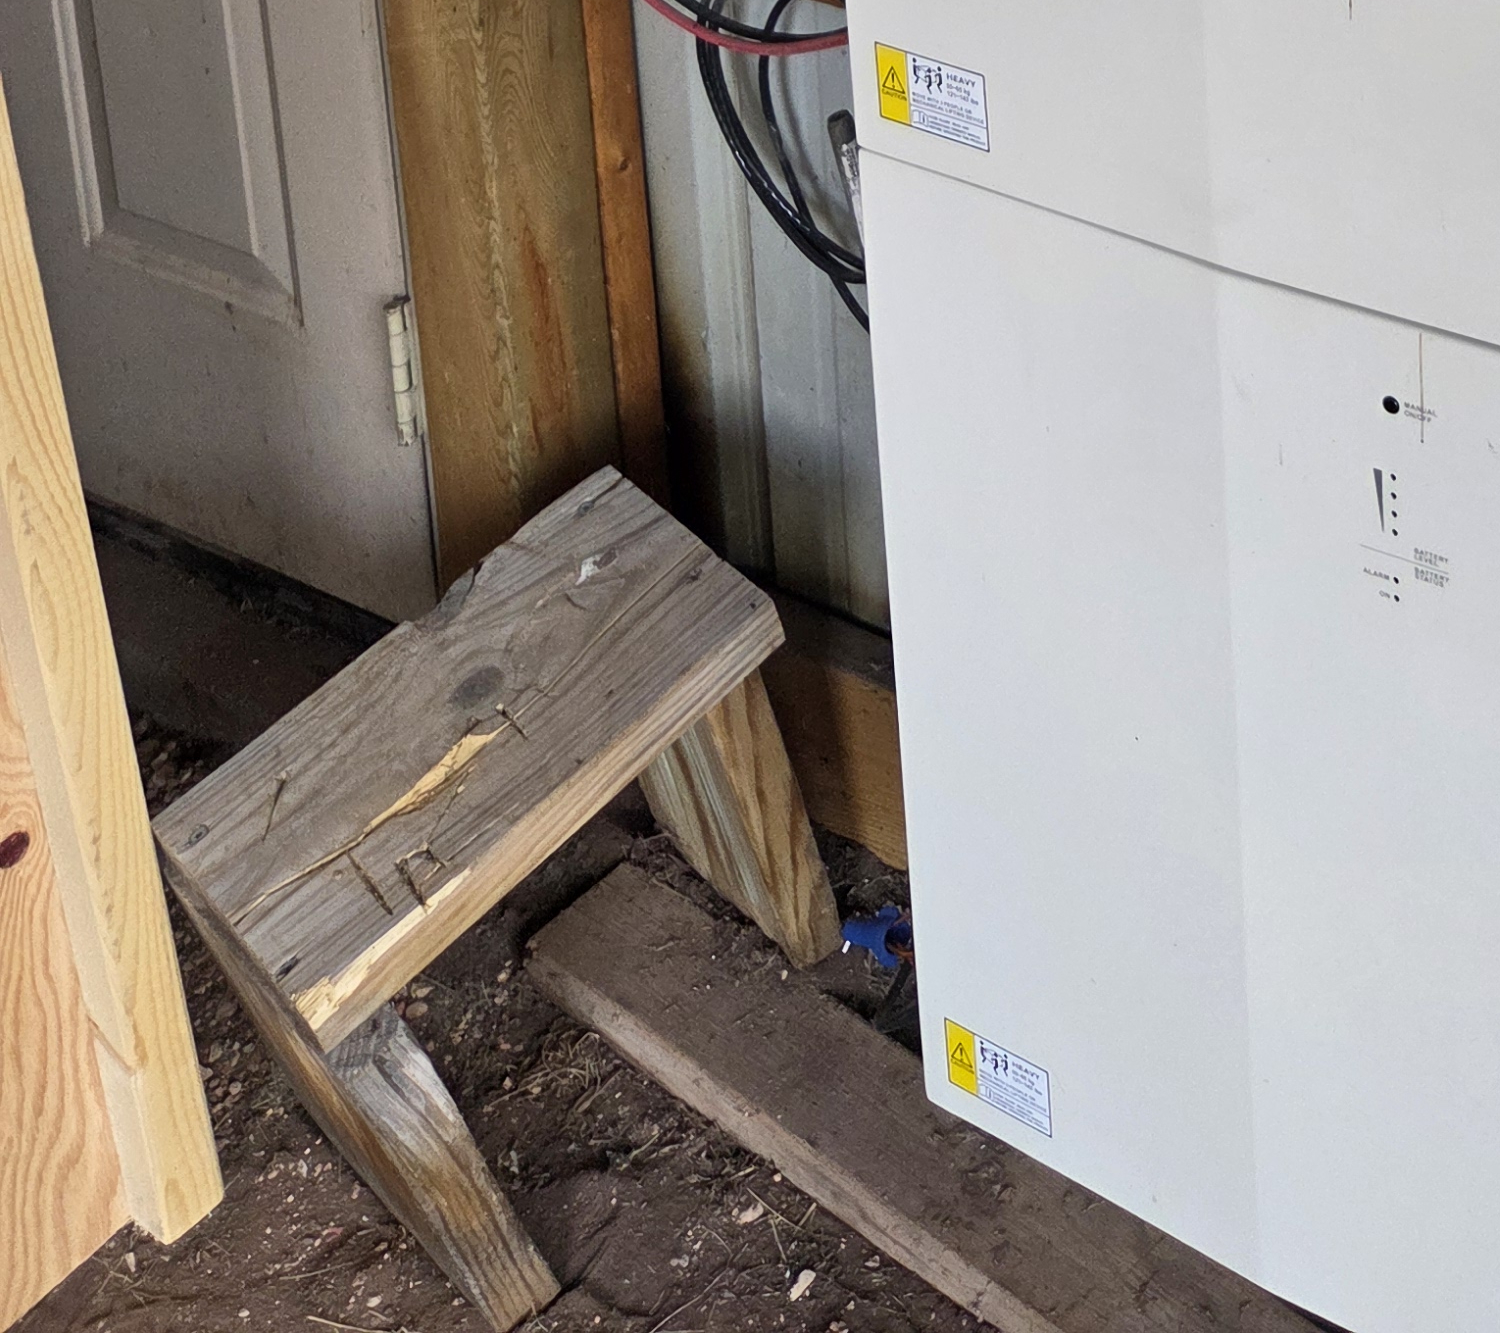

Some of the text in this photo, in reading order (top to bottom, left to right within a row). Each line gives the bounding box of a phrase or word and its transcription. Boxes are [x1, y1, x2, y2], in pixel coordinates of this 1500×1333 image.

[946, 72, 976, 88] HEAVY
[881, 88, 907, 102] CAUTION
[1404, 401, 1437, 418] MANUAL
[1363, 567, 1390, 581] ALARM
[1379, 590, 1390, 599] ON
